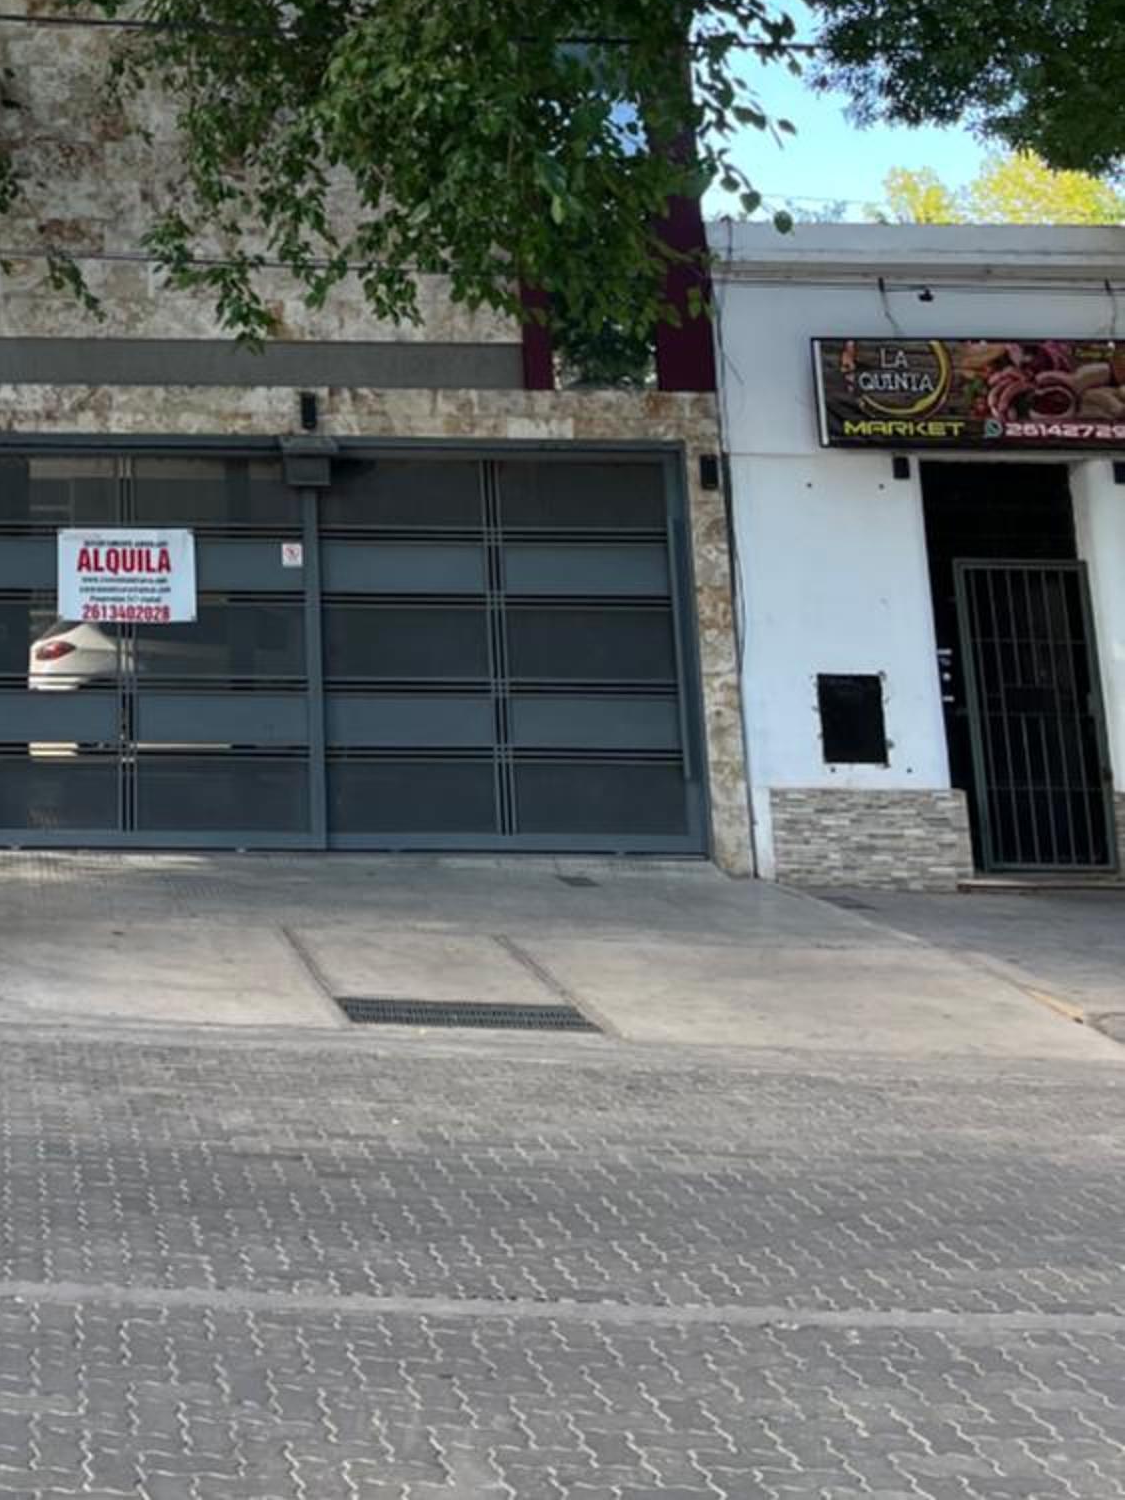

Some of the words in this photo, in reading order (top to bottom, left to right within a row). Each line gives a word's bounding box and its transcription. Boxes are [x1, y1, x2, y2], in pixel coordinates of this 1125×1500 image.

[879, 347, 909, 369] LA
[858, 371, 935, 392] QUINTA
[843, 420, 966, 437] MARKET
[76, 547, 172, 575] ALQUILA
